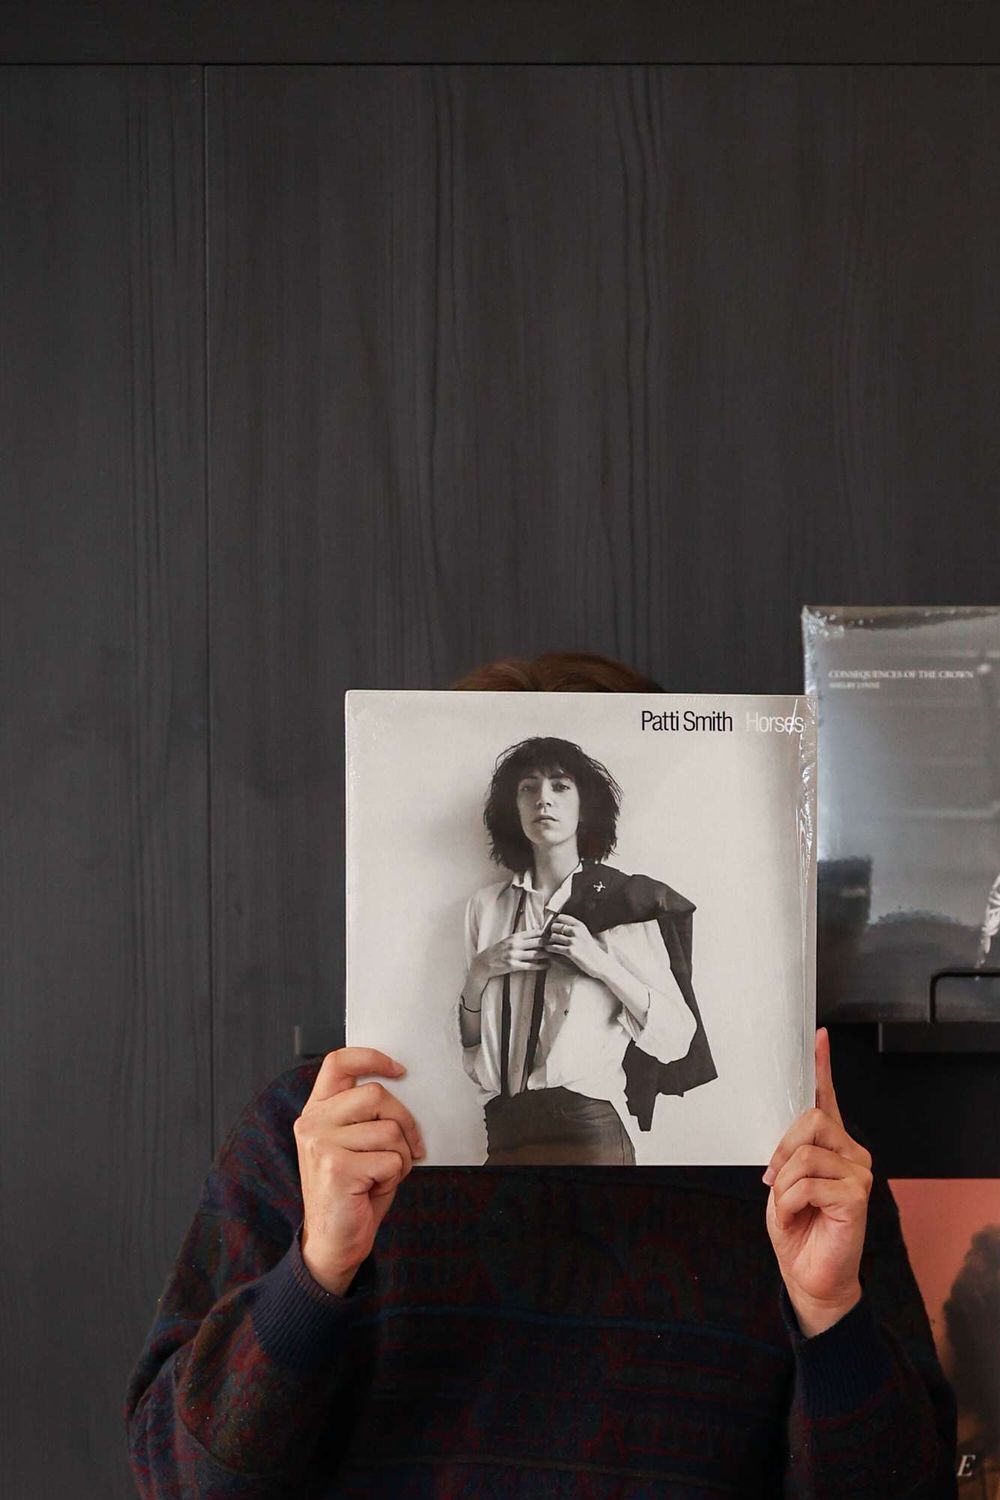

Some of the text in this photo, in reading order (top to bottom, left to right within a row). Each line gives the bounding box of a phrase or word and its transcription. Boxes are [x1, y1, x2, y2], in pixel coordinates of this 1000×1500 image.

[828, 670, 974, 679] CONSEQUENCES OF THE CROWN
[641, 710, 804, 733] Patti Smith Horses
